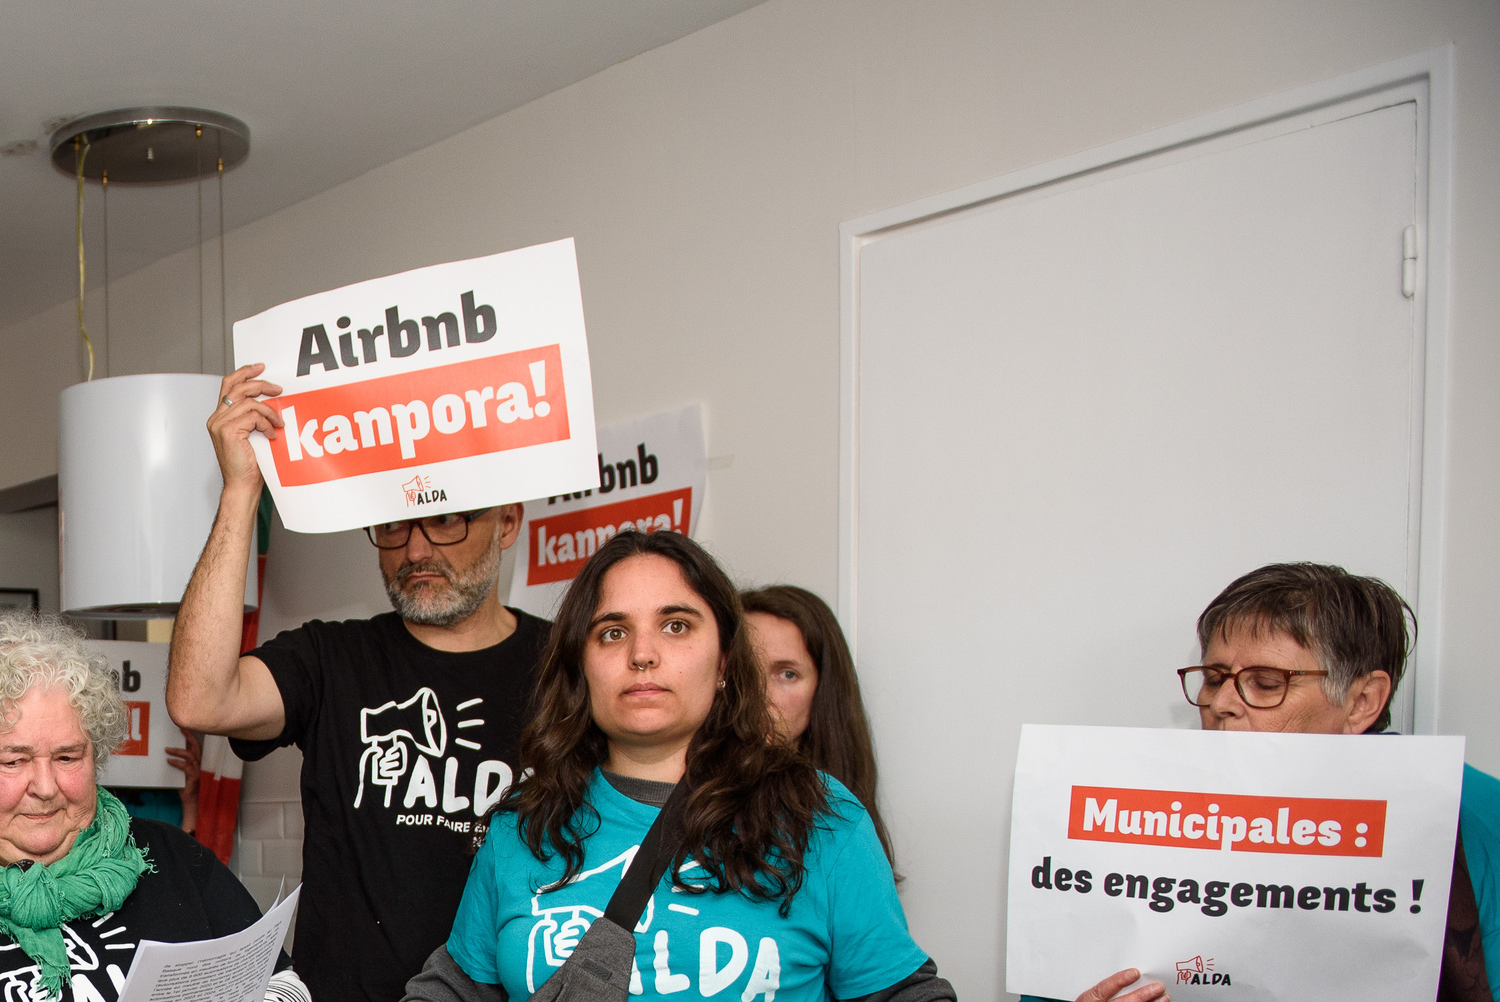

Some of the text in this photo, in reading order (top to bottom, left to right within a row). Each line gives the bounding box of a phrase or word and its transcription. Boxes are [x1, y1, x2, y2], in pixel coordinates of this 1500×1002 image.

[296, 289, 498, 378] Airbnb
[280, 359, 552, 463] kanpora!
[416, 487, 448, 506] ALDA
[396, 814, 434, 826] POUR
[436, 815, 471, 833] FAIRE
[1082, 796, 1368, 851] Municipales :
[1031, 856, 1425, 917] des engagements !
[1191, 973, 1232, 987] ALDA
